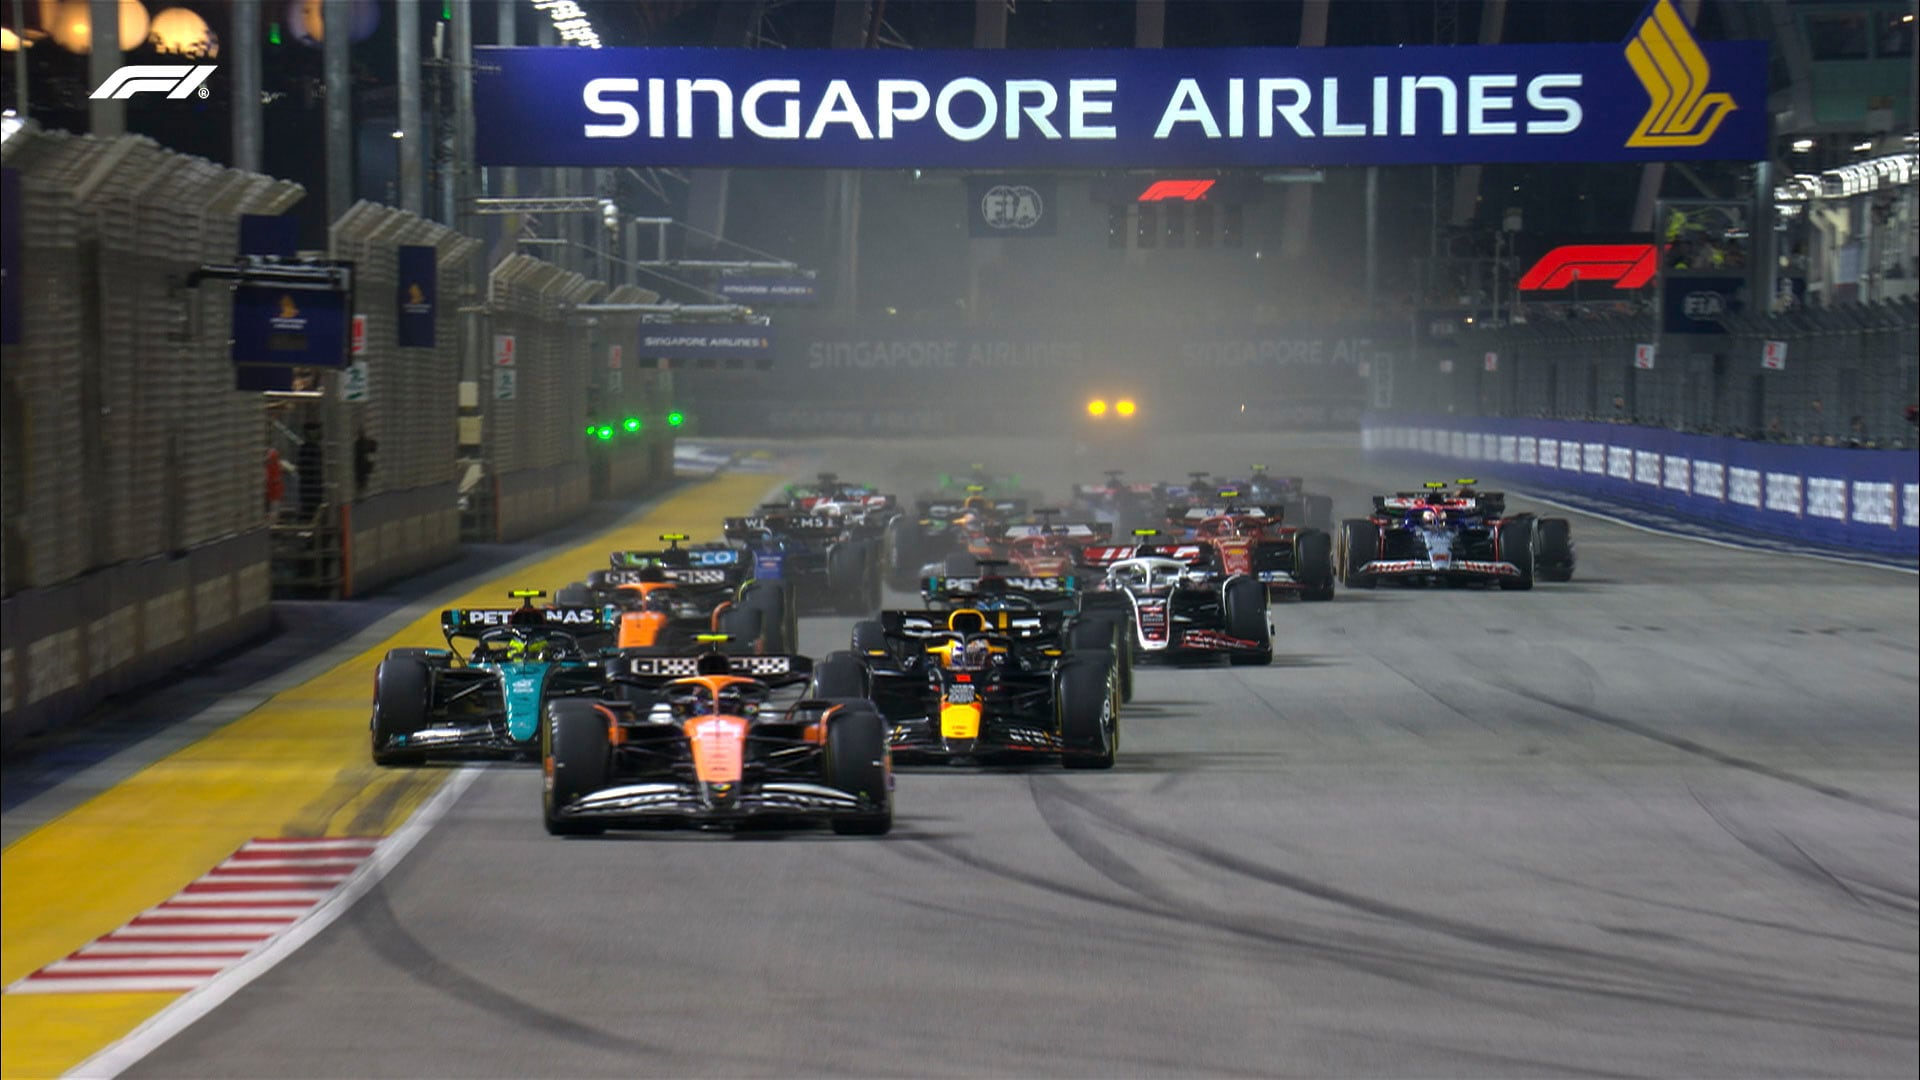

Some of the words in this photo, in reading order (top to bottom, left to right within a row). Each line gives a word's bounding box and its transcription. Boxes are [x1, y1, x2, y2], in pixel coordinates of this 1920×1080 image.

[583, 77, 1117, 141] SINGAPORE
[1153, 73, 1583, 138] AIRLINES
[644, 337, 706, 347] SINGAPORE
